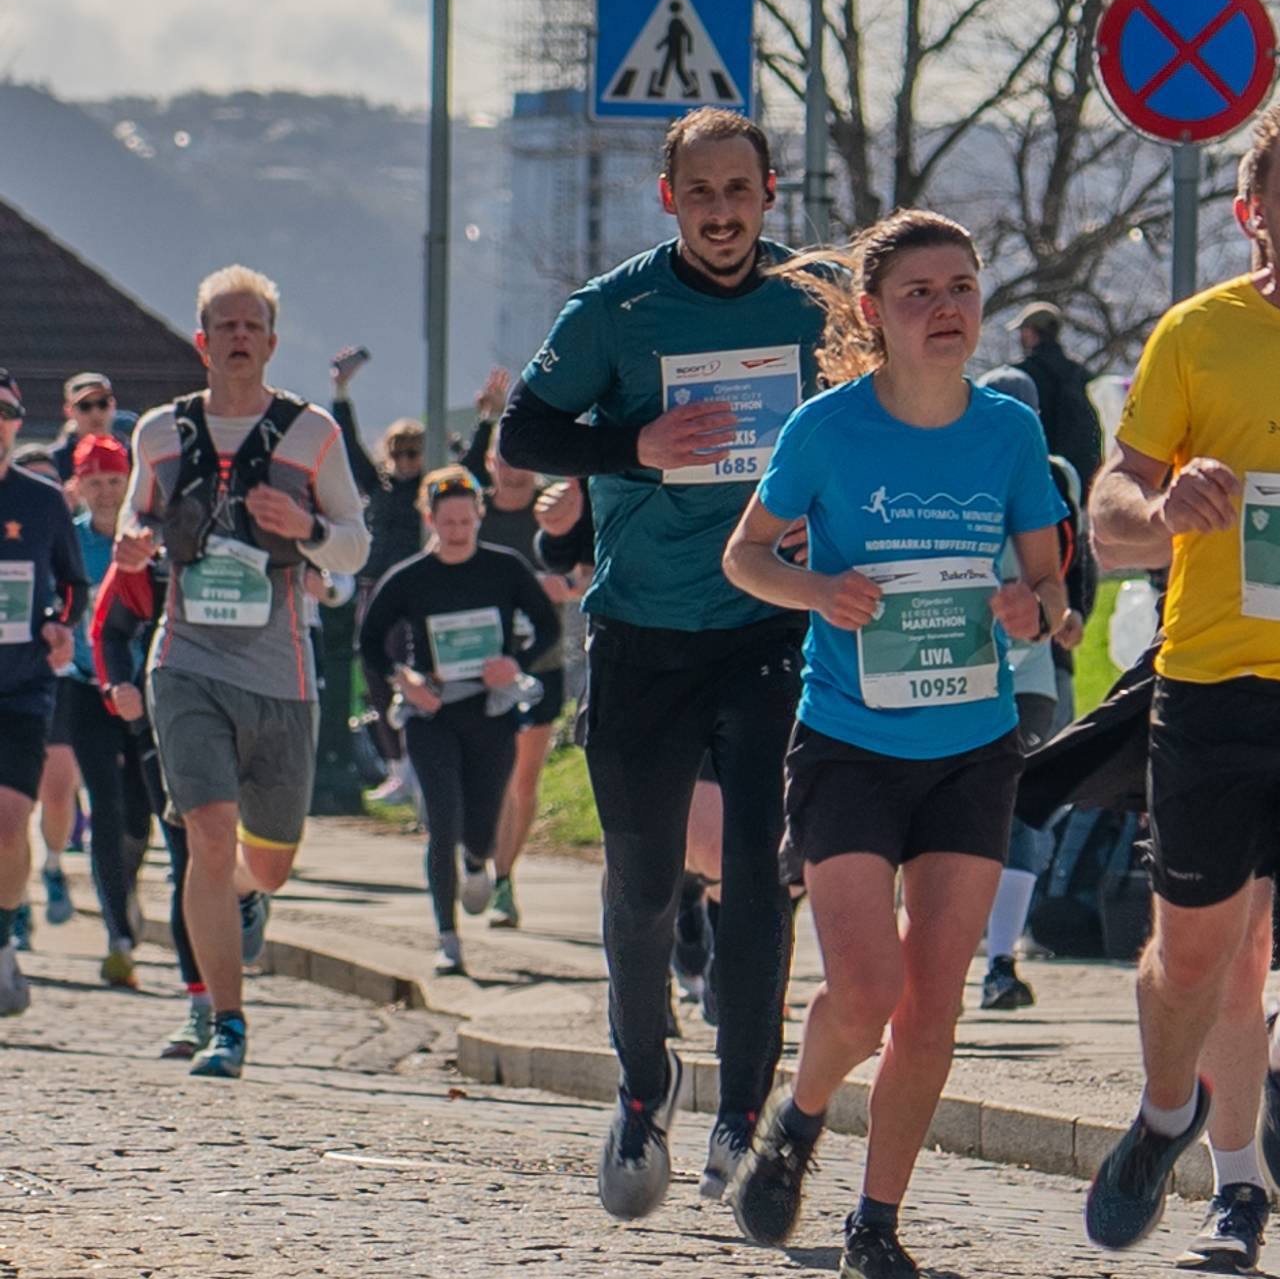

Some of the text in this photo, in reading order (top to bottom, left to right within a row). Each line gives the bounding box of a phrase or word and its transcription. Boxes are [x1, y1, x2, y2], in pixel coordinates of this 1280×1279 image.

[713, 456, 758, 476] 1685
[890, 508, 915, 520] IVAR
[865, 538, 932, 552] NORDMARKAS
[902, 616, 966, 631] MARATHON
[920, 647, 953, 666] LIVA
[910, 676, 968, 698] 10952
